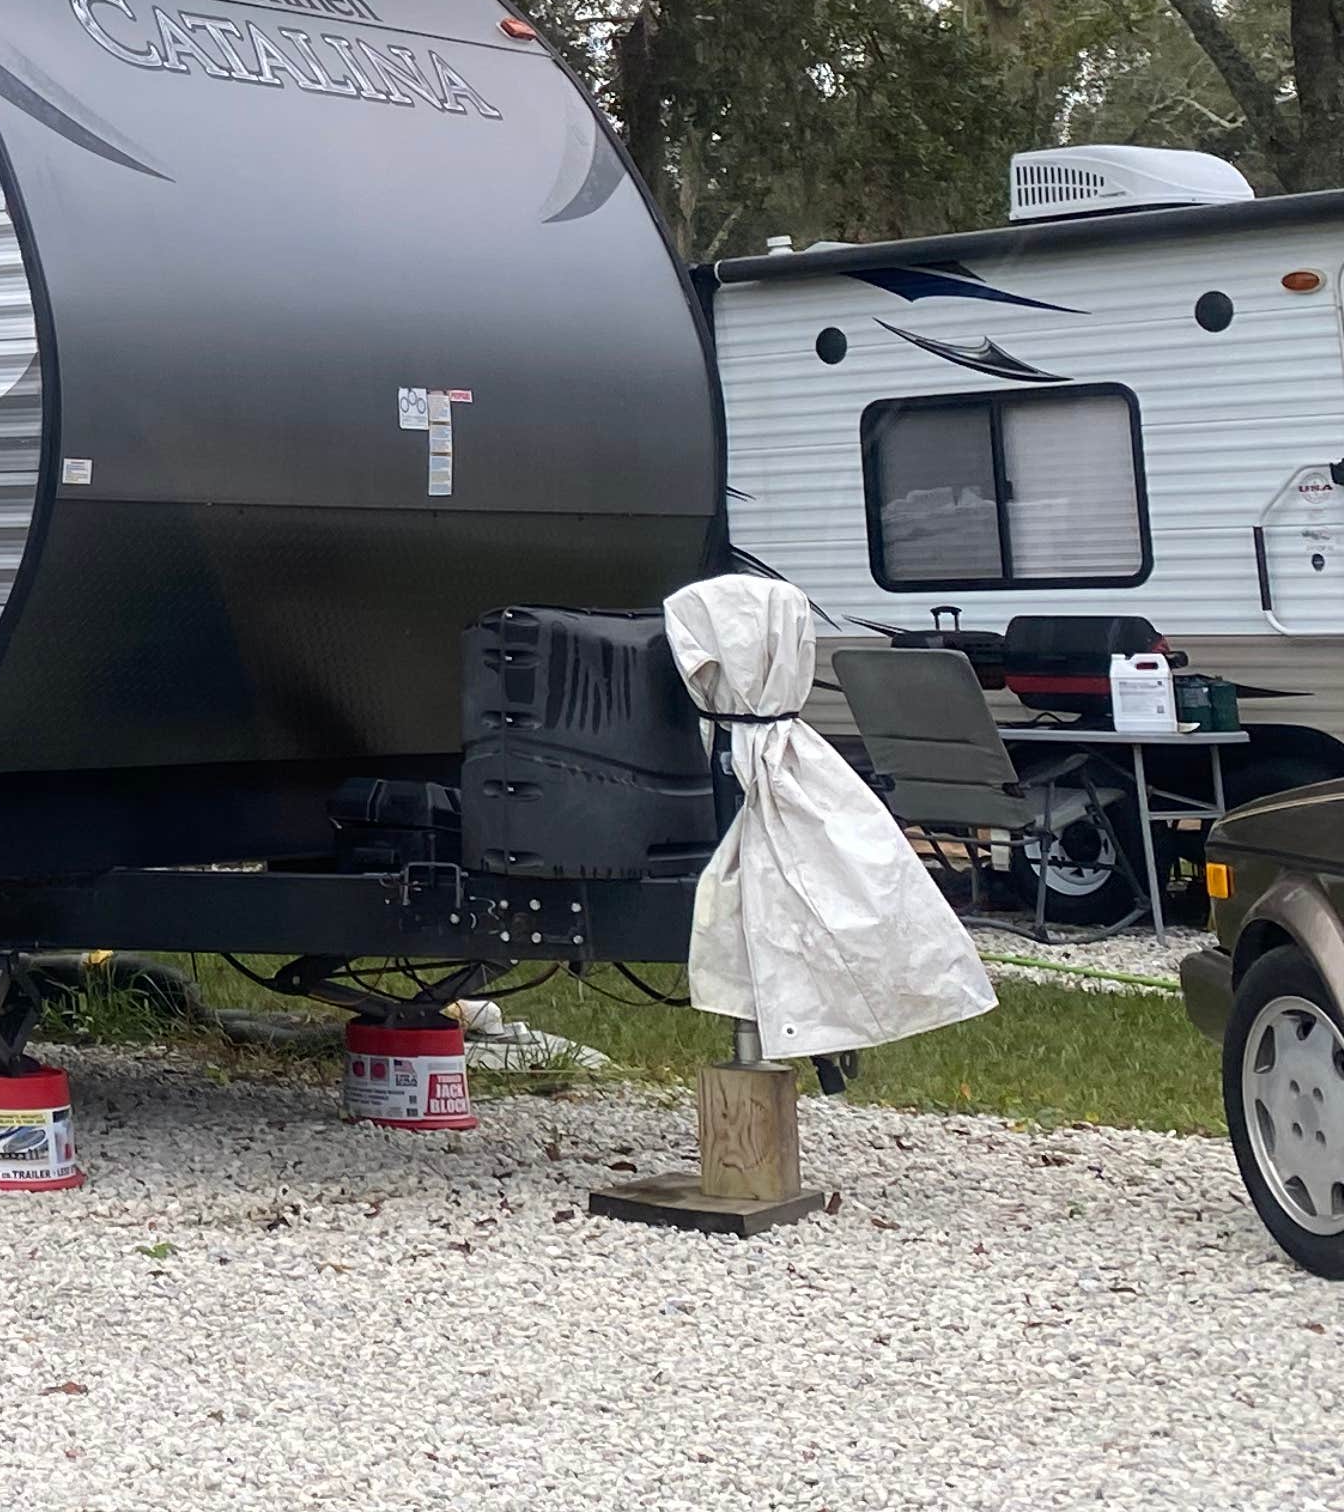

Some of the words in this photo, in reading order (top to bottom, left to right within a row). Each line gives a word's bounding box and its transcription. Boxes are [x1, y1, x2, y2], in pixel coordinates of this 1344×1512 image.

[435, 1083, 464, 1098] JACK
[430, 1099, 467, 1113] BLOCK
[12, 1169, 51, 1179] TRAILER
